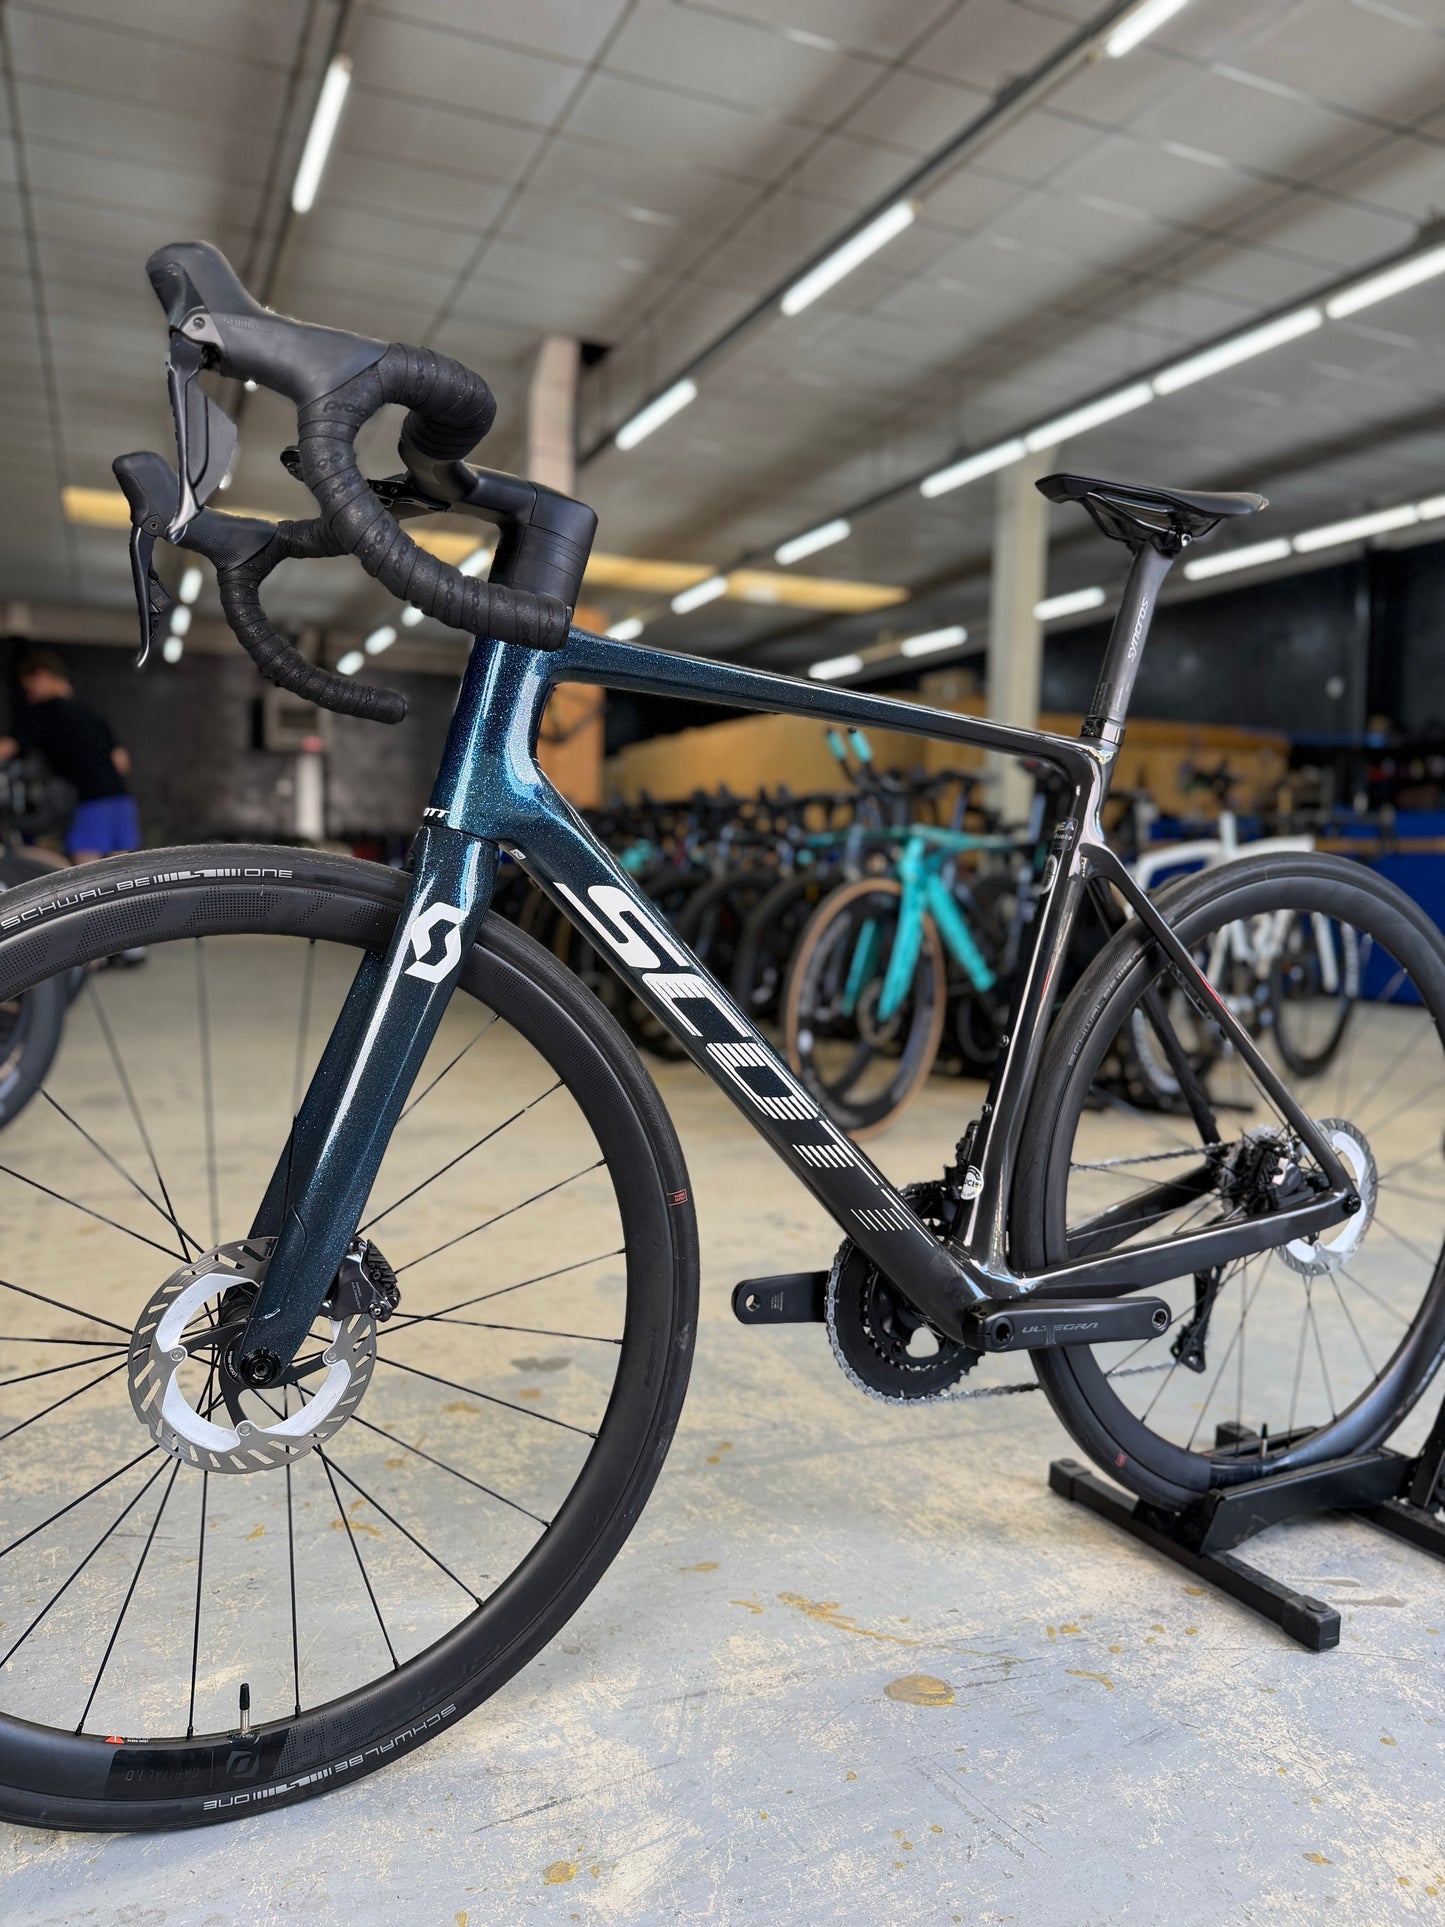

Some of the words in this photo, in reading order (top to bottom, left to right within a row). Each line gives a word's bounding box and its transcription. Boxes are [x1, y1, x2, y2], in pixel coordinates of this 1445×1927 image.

[1127, 596, 1149, 663] syncros
[1, 876, 151, 930] SCHWALBE
[244, 868, 293, 878] ONE
[554, 882, 938, 1247] SCOTT
[1021, 1321, 1100, 1334] ULTEGRA
[334, 1703, 458, 1774] SCHWALBE
[203, 1794, 250, 1811] ONE
